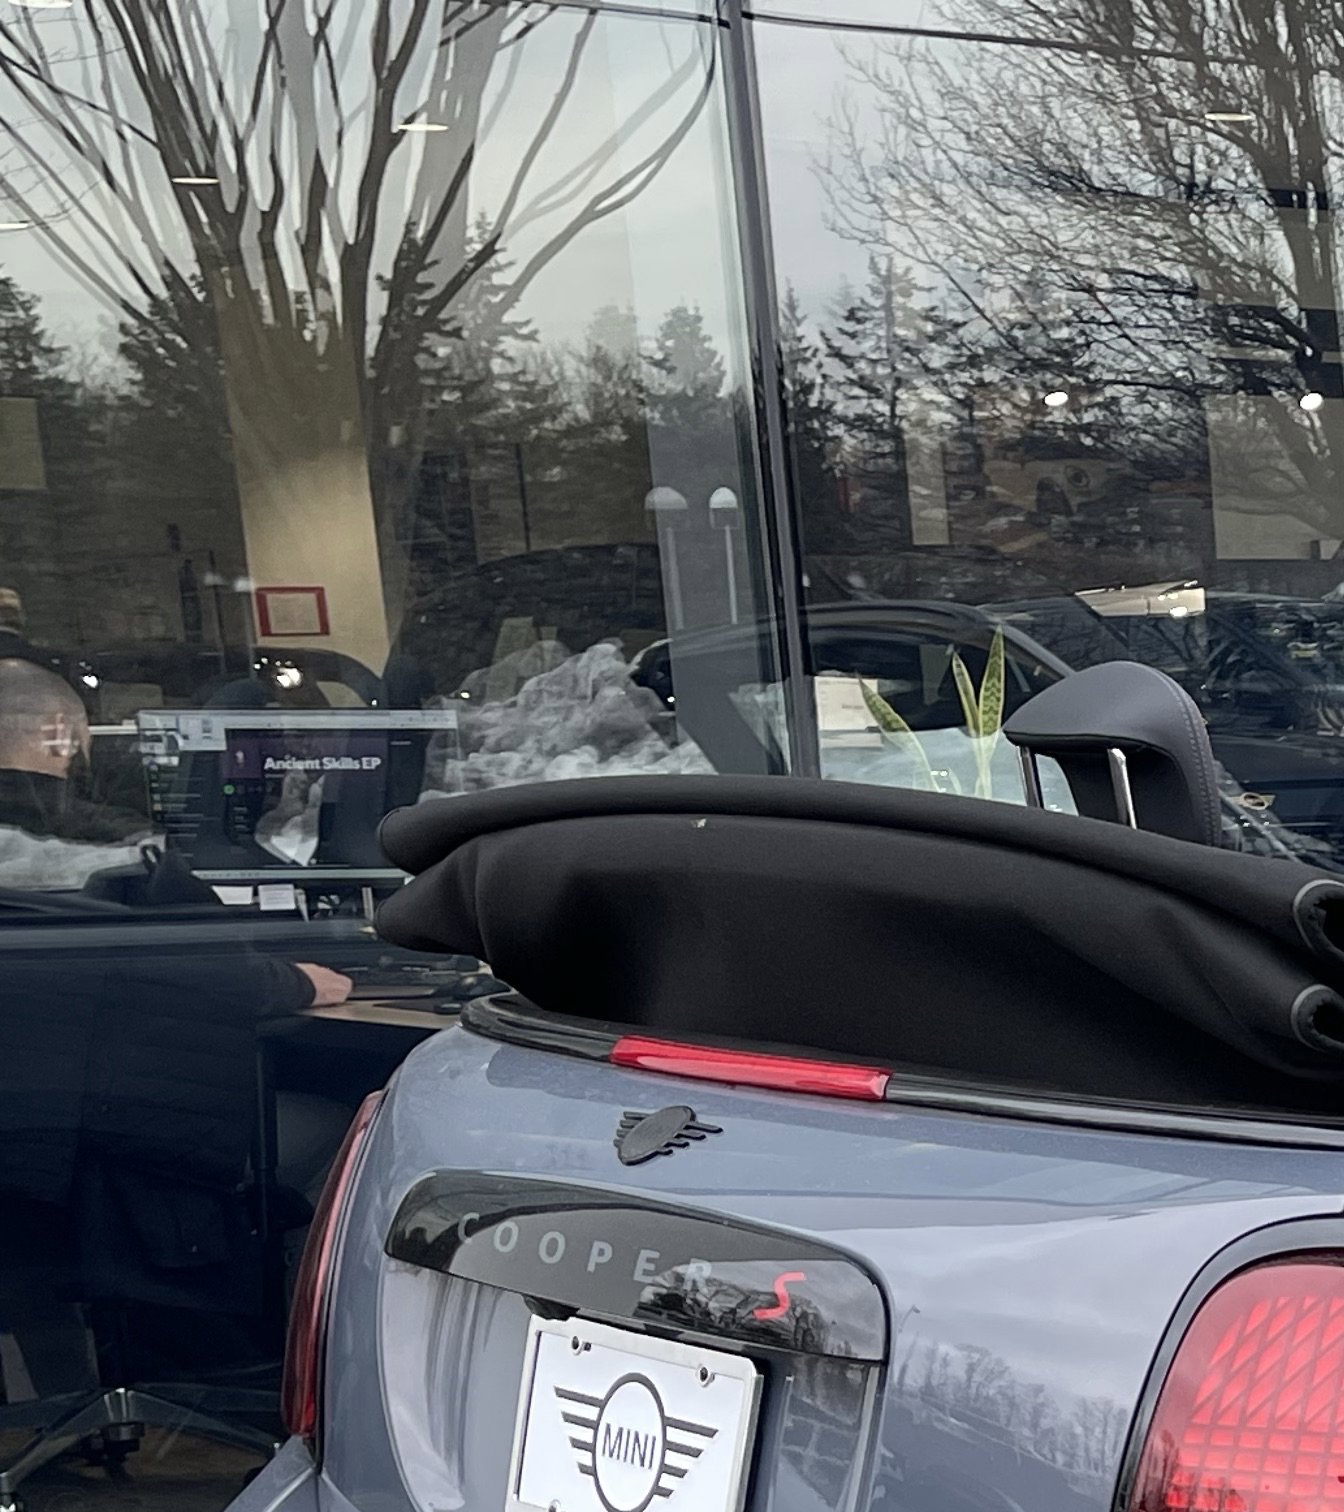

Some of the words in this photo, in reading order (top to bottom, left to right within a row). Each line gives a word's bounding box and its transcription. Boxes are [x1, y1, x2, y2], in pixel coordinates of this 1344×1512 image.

[264, 756, 320, 771] Ancient
[322, 756, 361, 771] Skills
[362, 757, 382, 770] EP
[457, 1211, 713, 1293] COOPER
[753, 1271, 807, 1320] S
[601, 1422, 657, 1470] MINI
